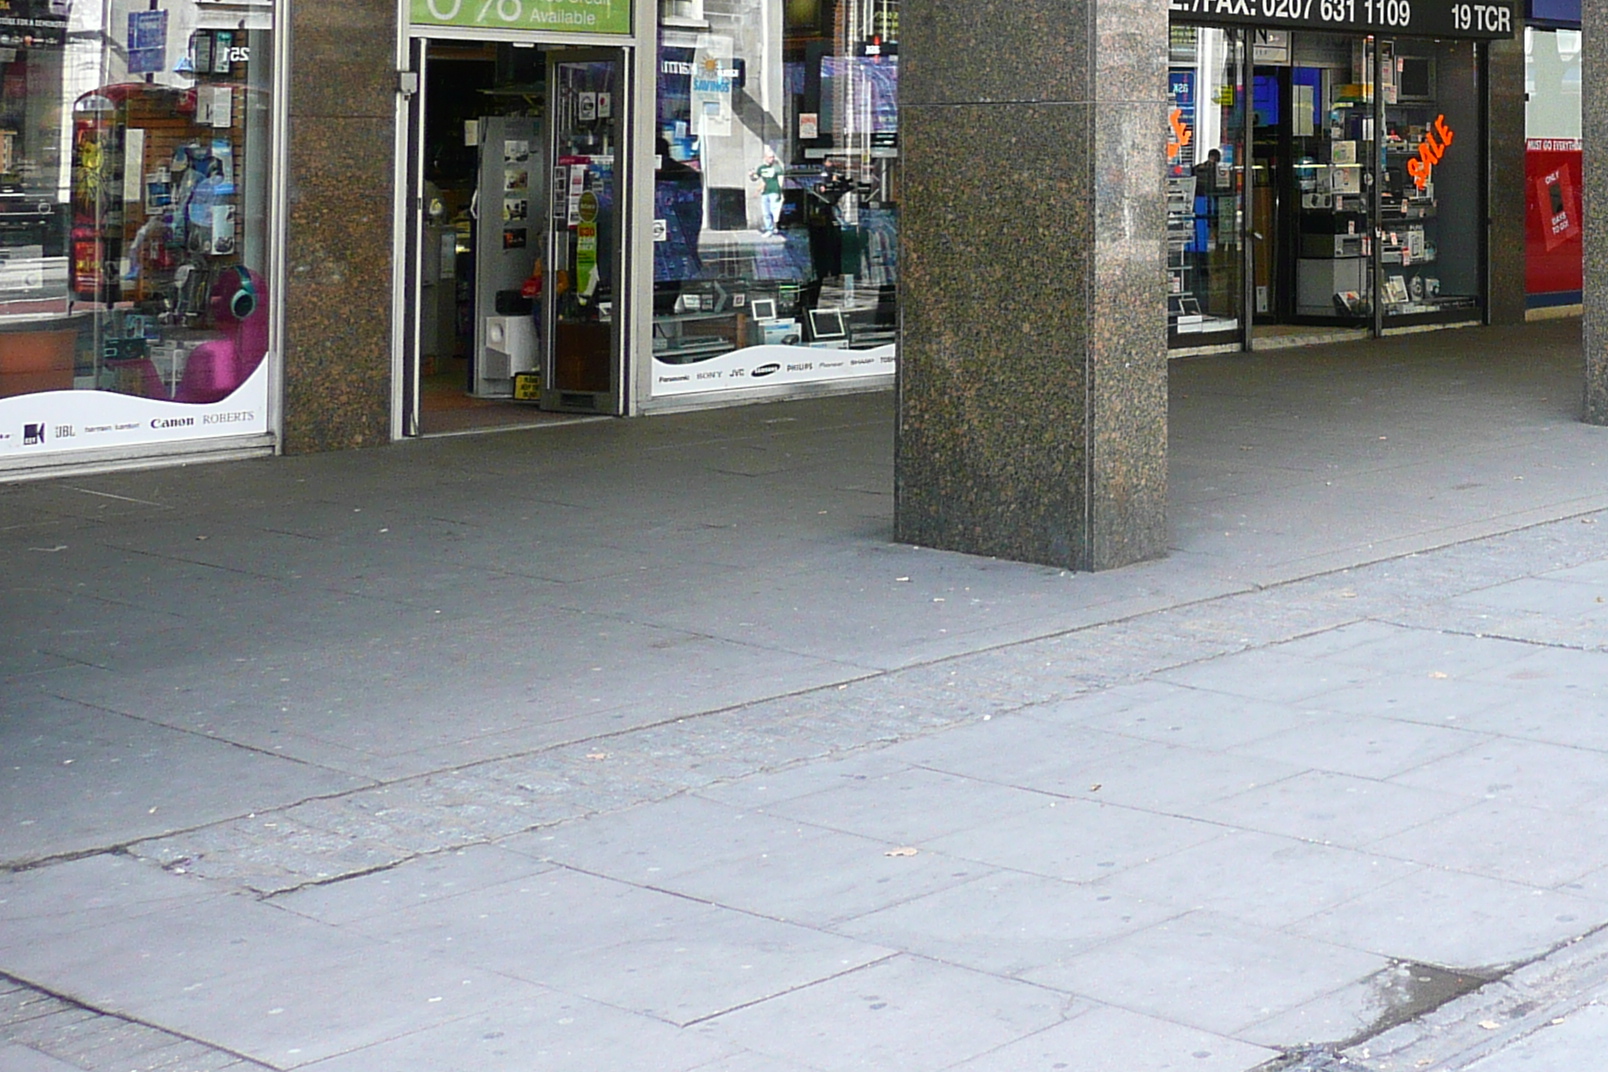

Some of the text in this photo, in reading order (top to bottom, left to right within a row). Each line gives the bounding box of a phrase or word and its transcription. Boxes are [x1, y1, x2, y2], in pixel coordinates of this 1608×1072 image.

[529, 8, 597, 27] Available
[1451, 3, 1472, 31] 19
[1472, 5, 1512, 33] TCR
[696, 371, 723, 380] SONY
[729, 368, 745, 377] JVC
[150, 416, 195, 430] Canon
[202, 410, 255, 425] ROBERTS
